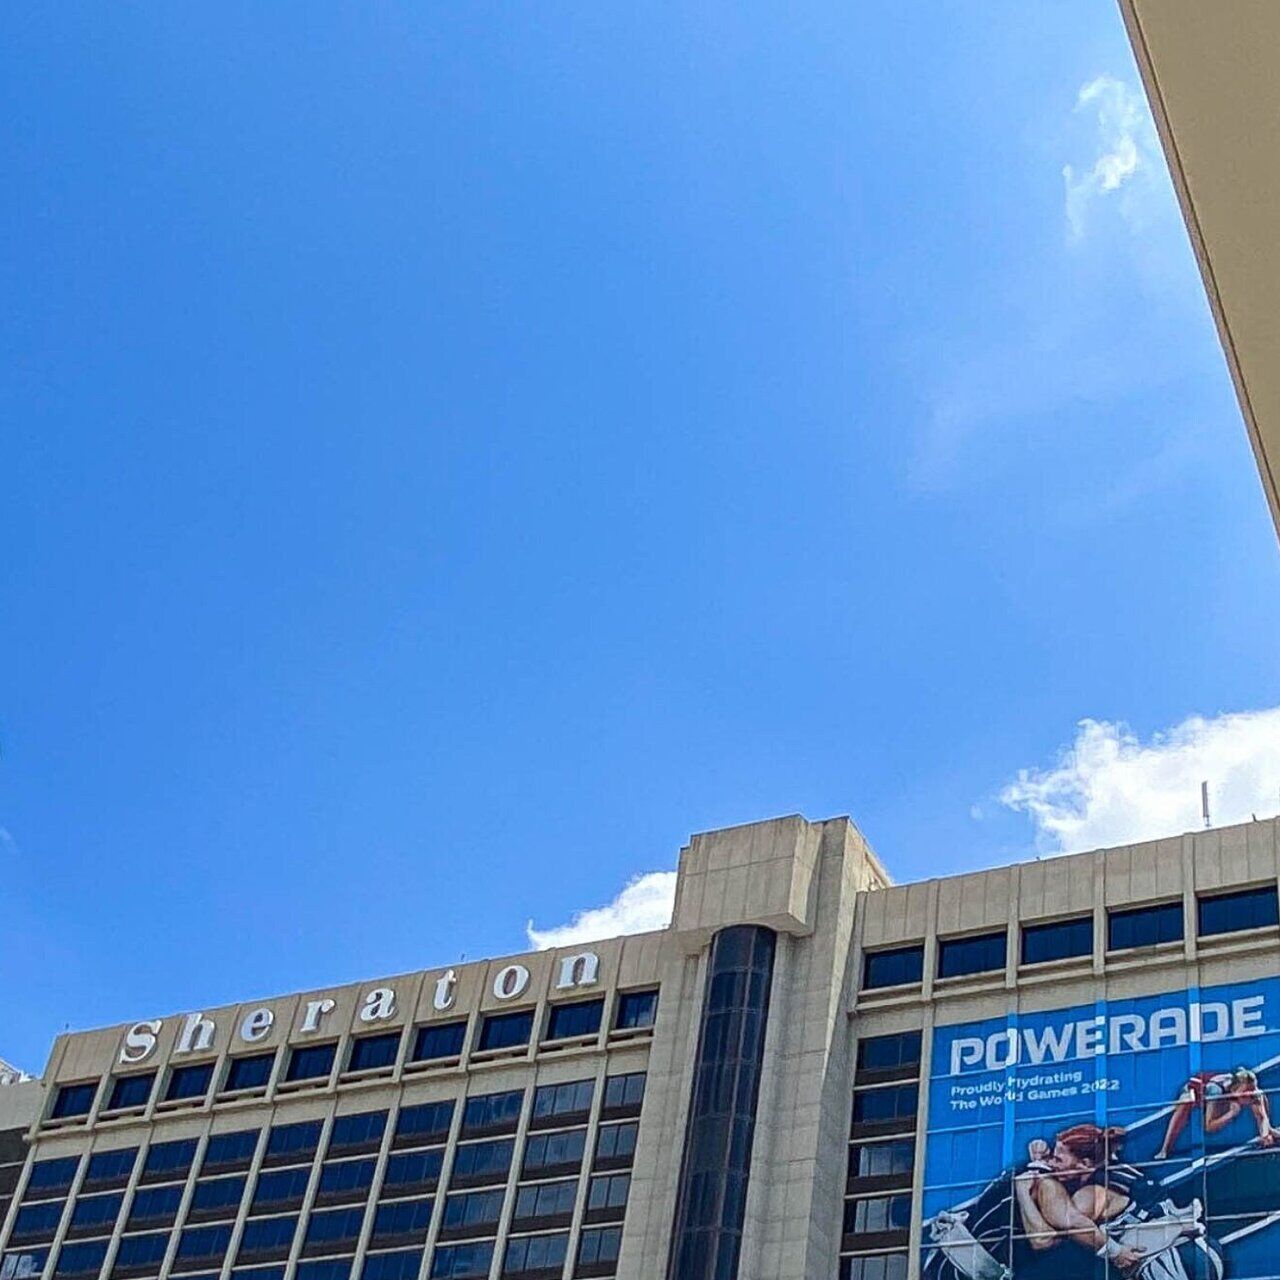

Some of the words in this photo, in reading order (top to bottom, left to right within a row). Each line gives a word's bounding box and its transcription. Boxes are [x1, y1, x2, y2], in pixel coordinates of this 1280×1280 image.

[120, 951, 598, 1063] Sheraton
[950, 995, 1266, 1075] POWERADE
[950, 1100, 977, 1110] The
[980, 1090, 1023, 1107] World
[1028, 1085, 1077, 1100] Games
[951, 1081, 1004, 1096] Proudly
[1008, 1071, 1082, 1089] Hydrating
